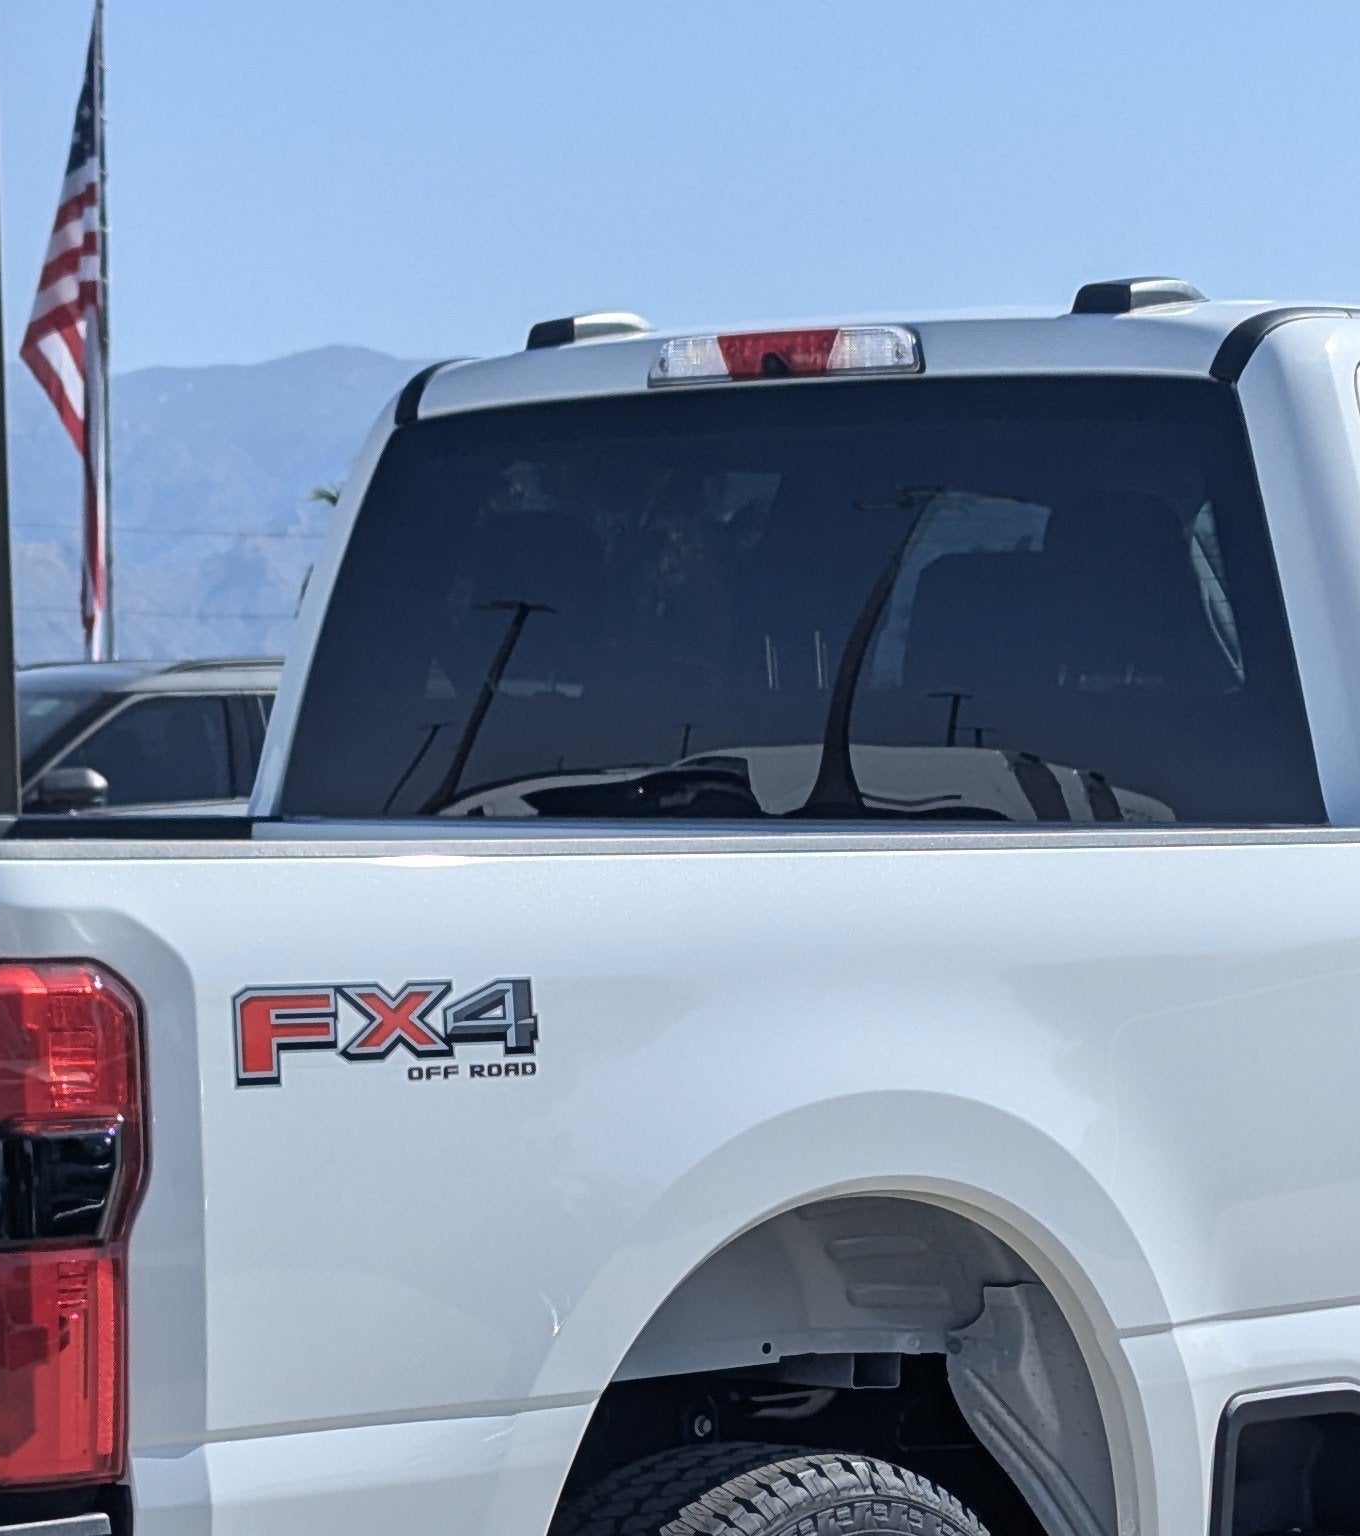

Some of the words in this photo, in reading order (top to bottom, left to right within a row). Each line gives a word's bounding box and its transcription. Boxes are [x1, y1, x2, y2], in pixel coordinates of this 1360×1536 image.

[232, 977, 539, 1089] FX4
[407, 1065, 460, 1081] OFF
[469, 1062, 537, 1079] ROAD
